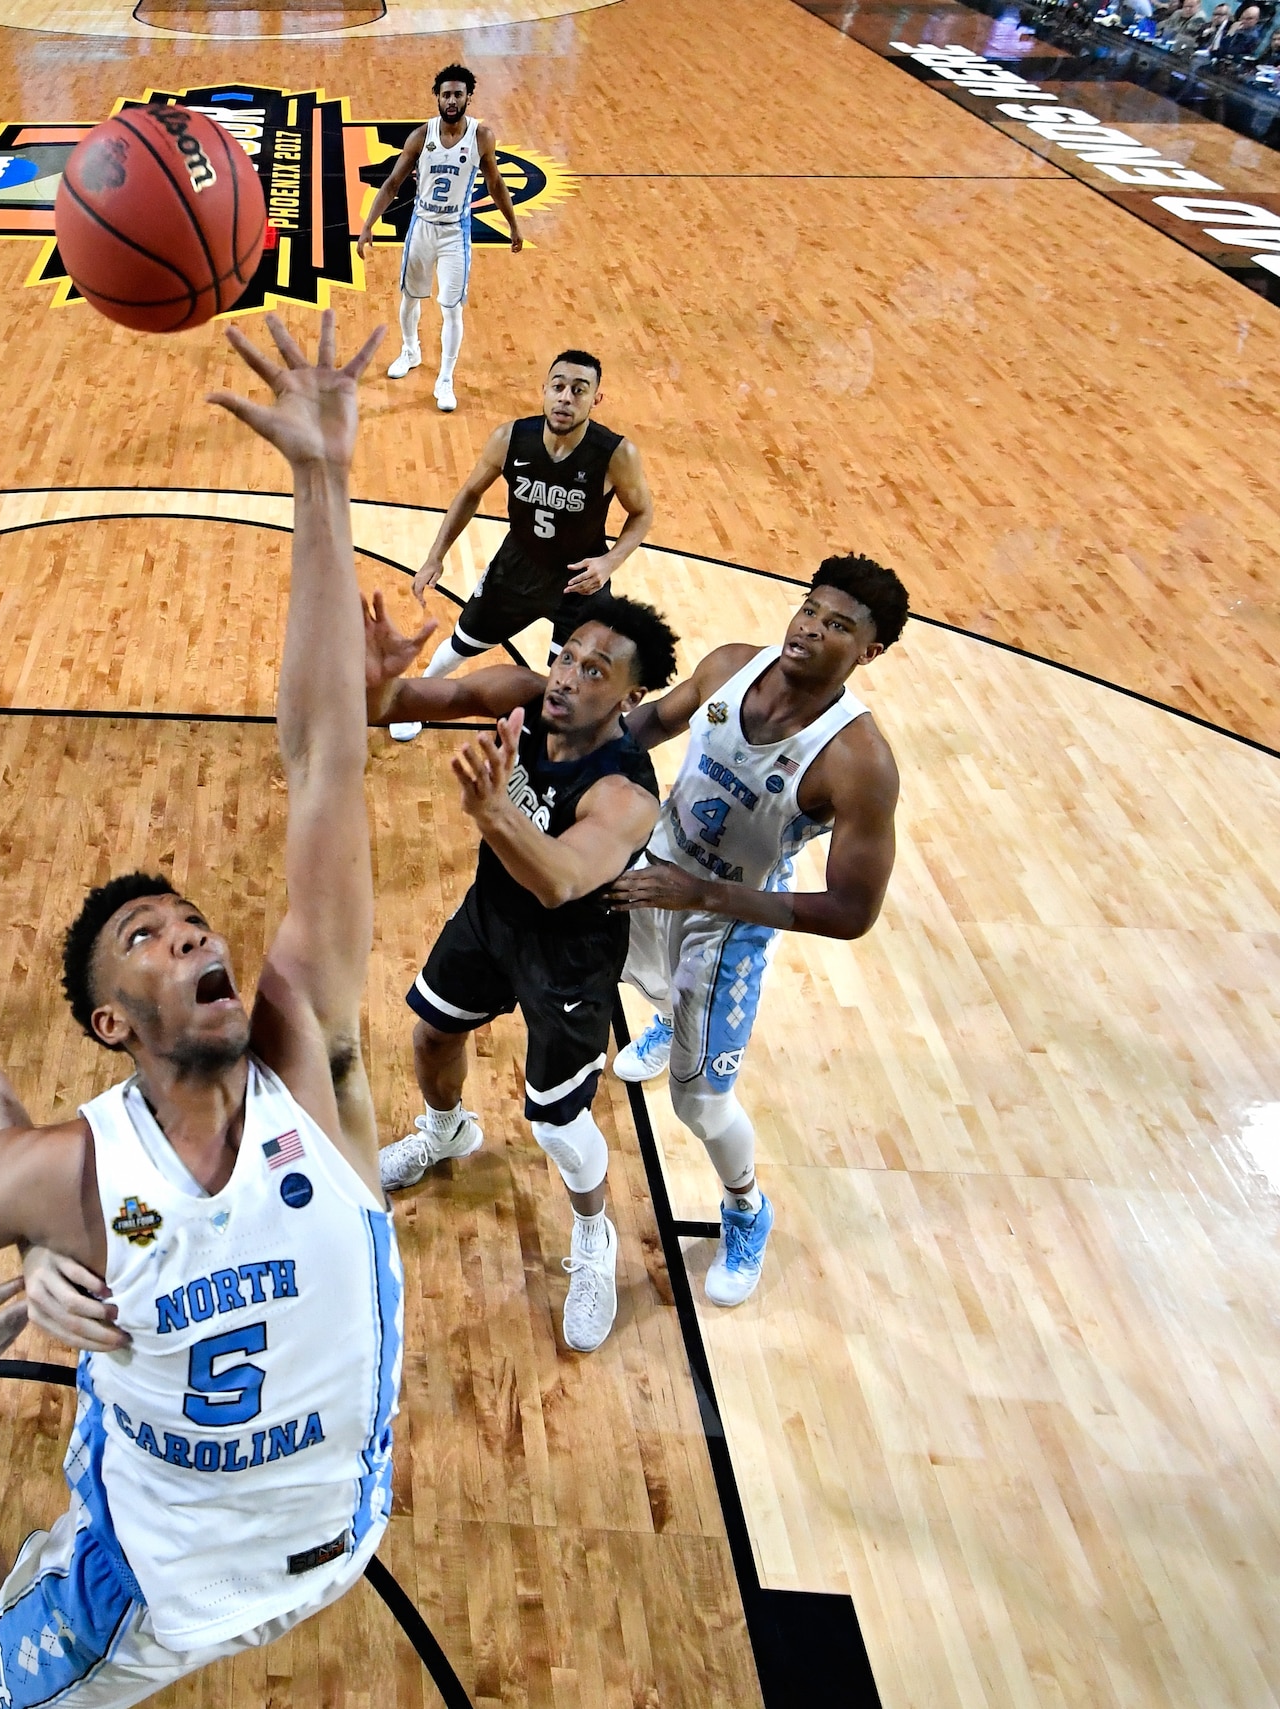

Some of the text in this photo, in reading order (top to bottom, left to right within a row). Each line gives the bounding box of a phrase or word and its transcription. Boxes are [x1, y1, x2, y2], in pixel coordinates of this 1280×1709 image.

[889, 41, 1059, 100] HERE
[274, 130, 302, 161] 2017
[430, 164, 460, 176] NORTH
[996, 103, 1224, 190] ENDS
[268, 163, 301, 229] PHOENIX
[432, 177, 451, 202] 2
[513, 475, 586, 512] ZAGS
[533, 508, 556, 539] 5
[507, 755, 550, 834] AGS
[698, 753, 759, 811] NORTH
[690, 797, 731, 848] 4
[155, 1259, 298, 1335] NORTH
[182, 1321, 268, 1428] 5
[113, 1411, 326, 1473] CAROLINA
